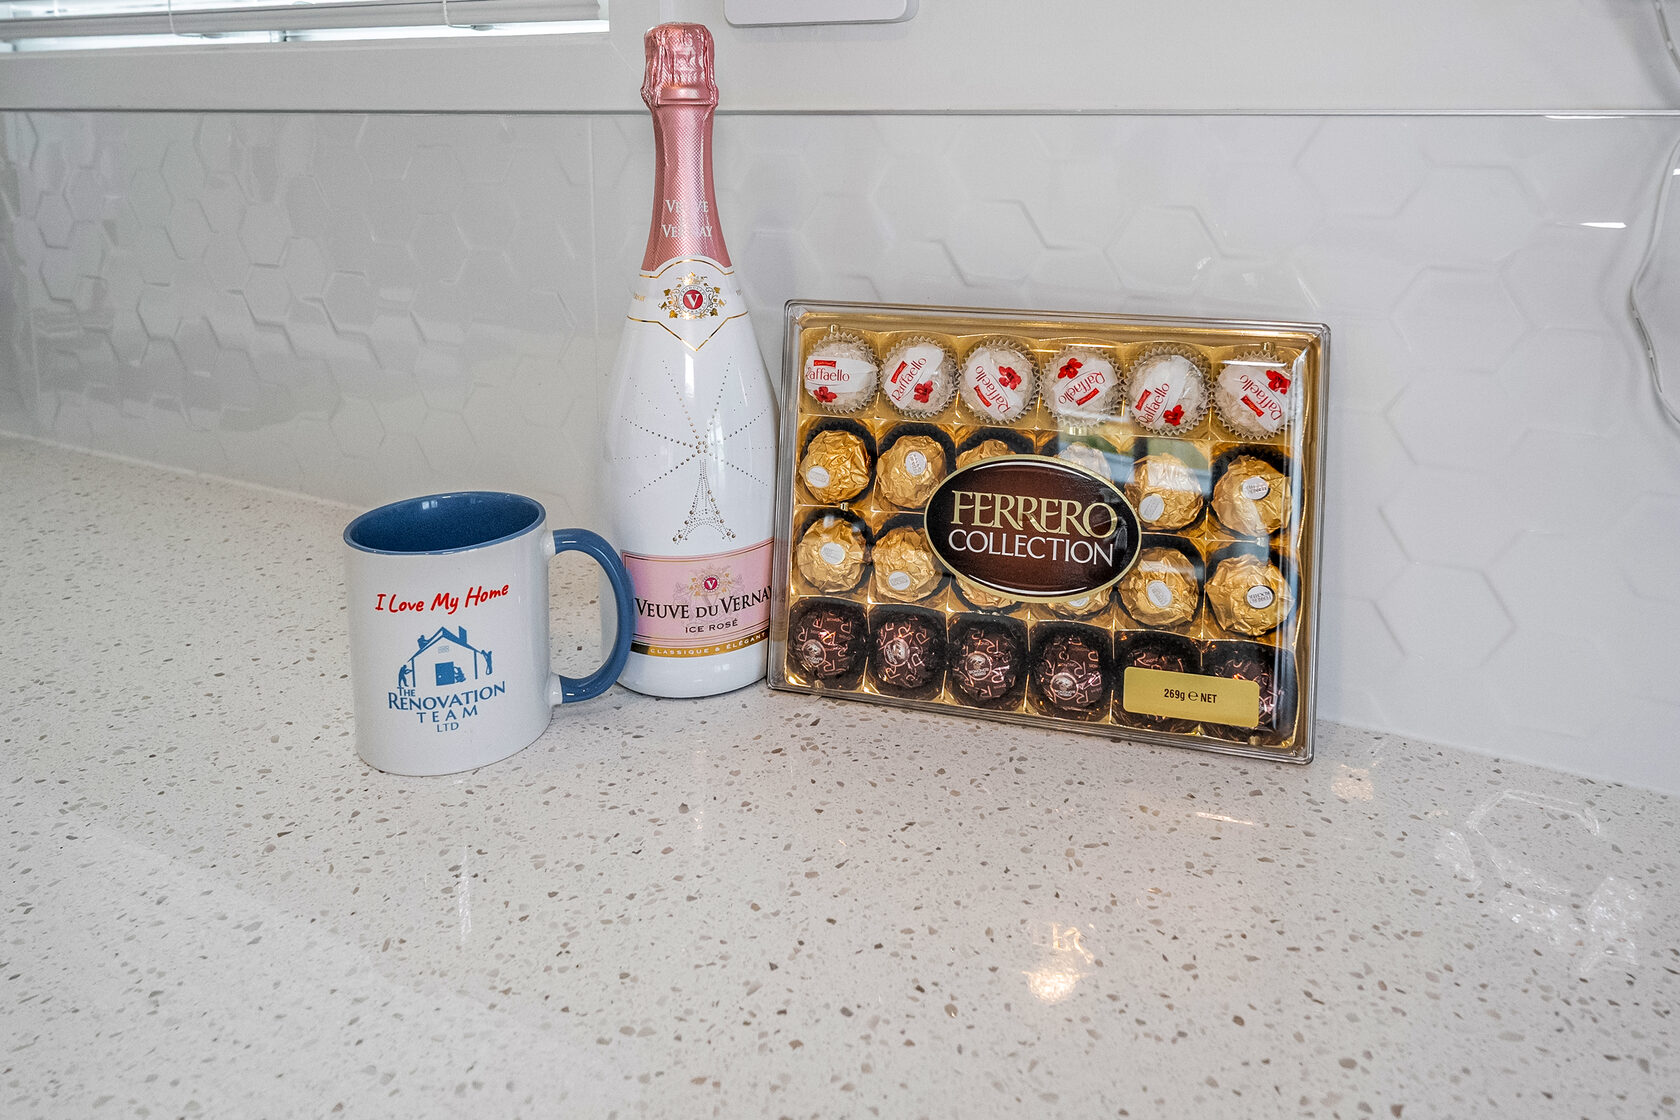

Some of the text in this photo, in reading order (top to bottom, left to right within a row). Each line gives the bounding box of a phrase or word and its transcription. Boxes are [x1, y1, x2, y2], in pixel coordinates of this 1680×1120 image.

[686, 293, 701, 308] V
[891, 357, 927, 402] Raffaello
[975, 365, 1011, 413] Raffaello
[1058, 371, 1106, 404] Raffaello
[1239, 374, 1283, 421] Raffaello
[951, 489, 1118, 539] FERRERO
[948, 528, 1114, 568] COLLECTION
[706, 580, 716, 590] V
[374, 584, 509, 615] I Love My Home
[634, 597, 690, 619] VEUVE
[696, 604, 719, 618] DU
[685, 618, 739, 634] ICE ROSÉ
[650, 647, 710, 656] CLASSIQUE
[388, 681, 506, 711] RENOVATION
[397, 686, 416, 697] THE
[1163, 688, 1186, 702] 269g
[1200, 692, 1218, 703] NET
[416, 704, 479, 724] TEAM
[436, 722, 459, 733] LTD
